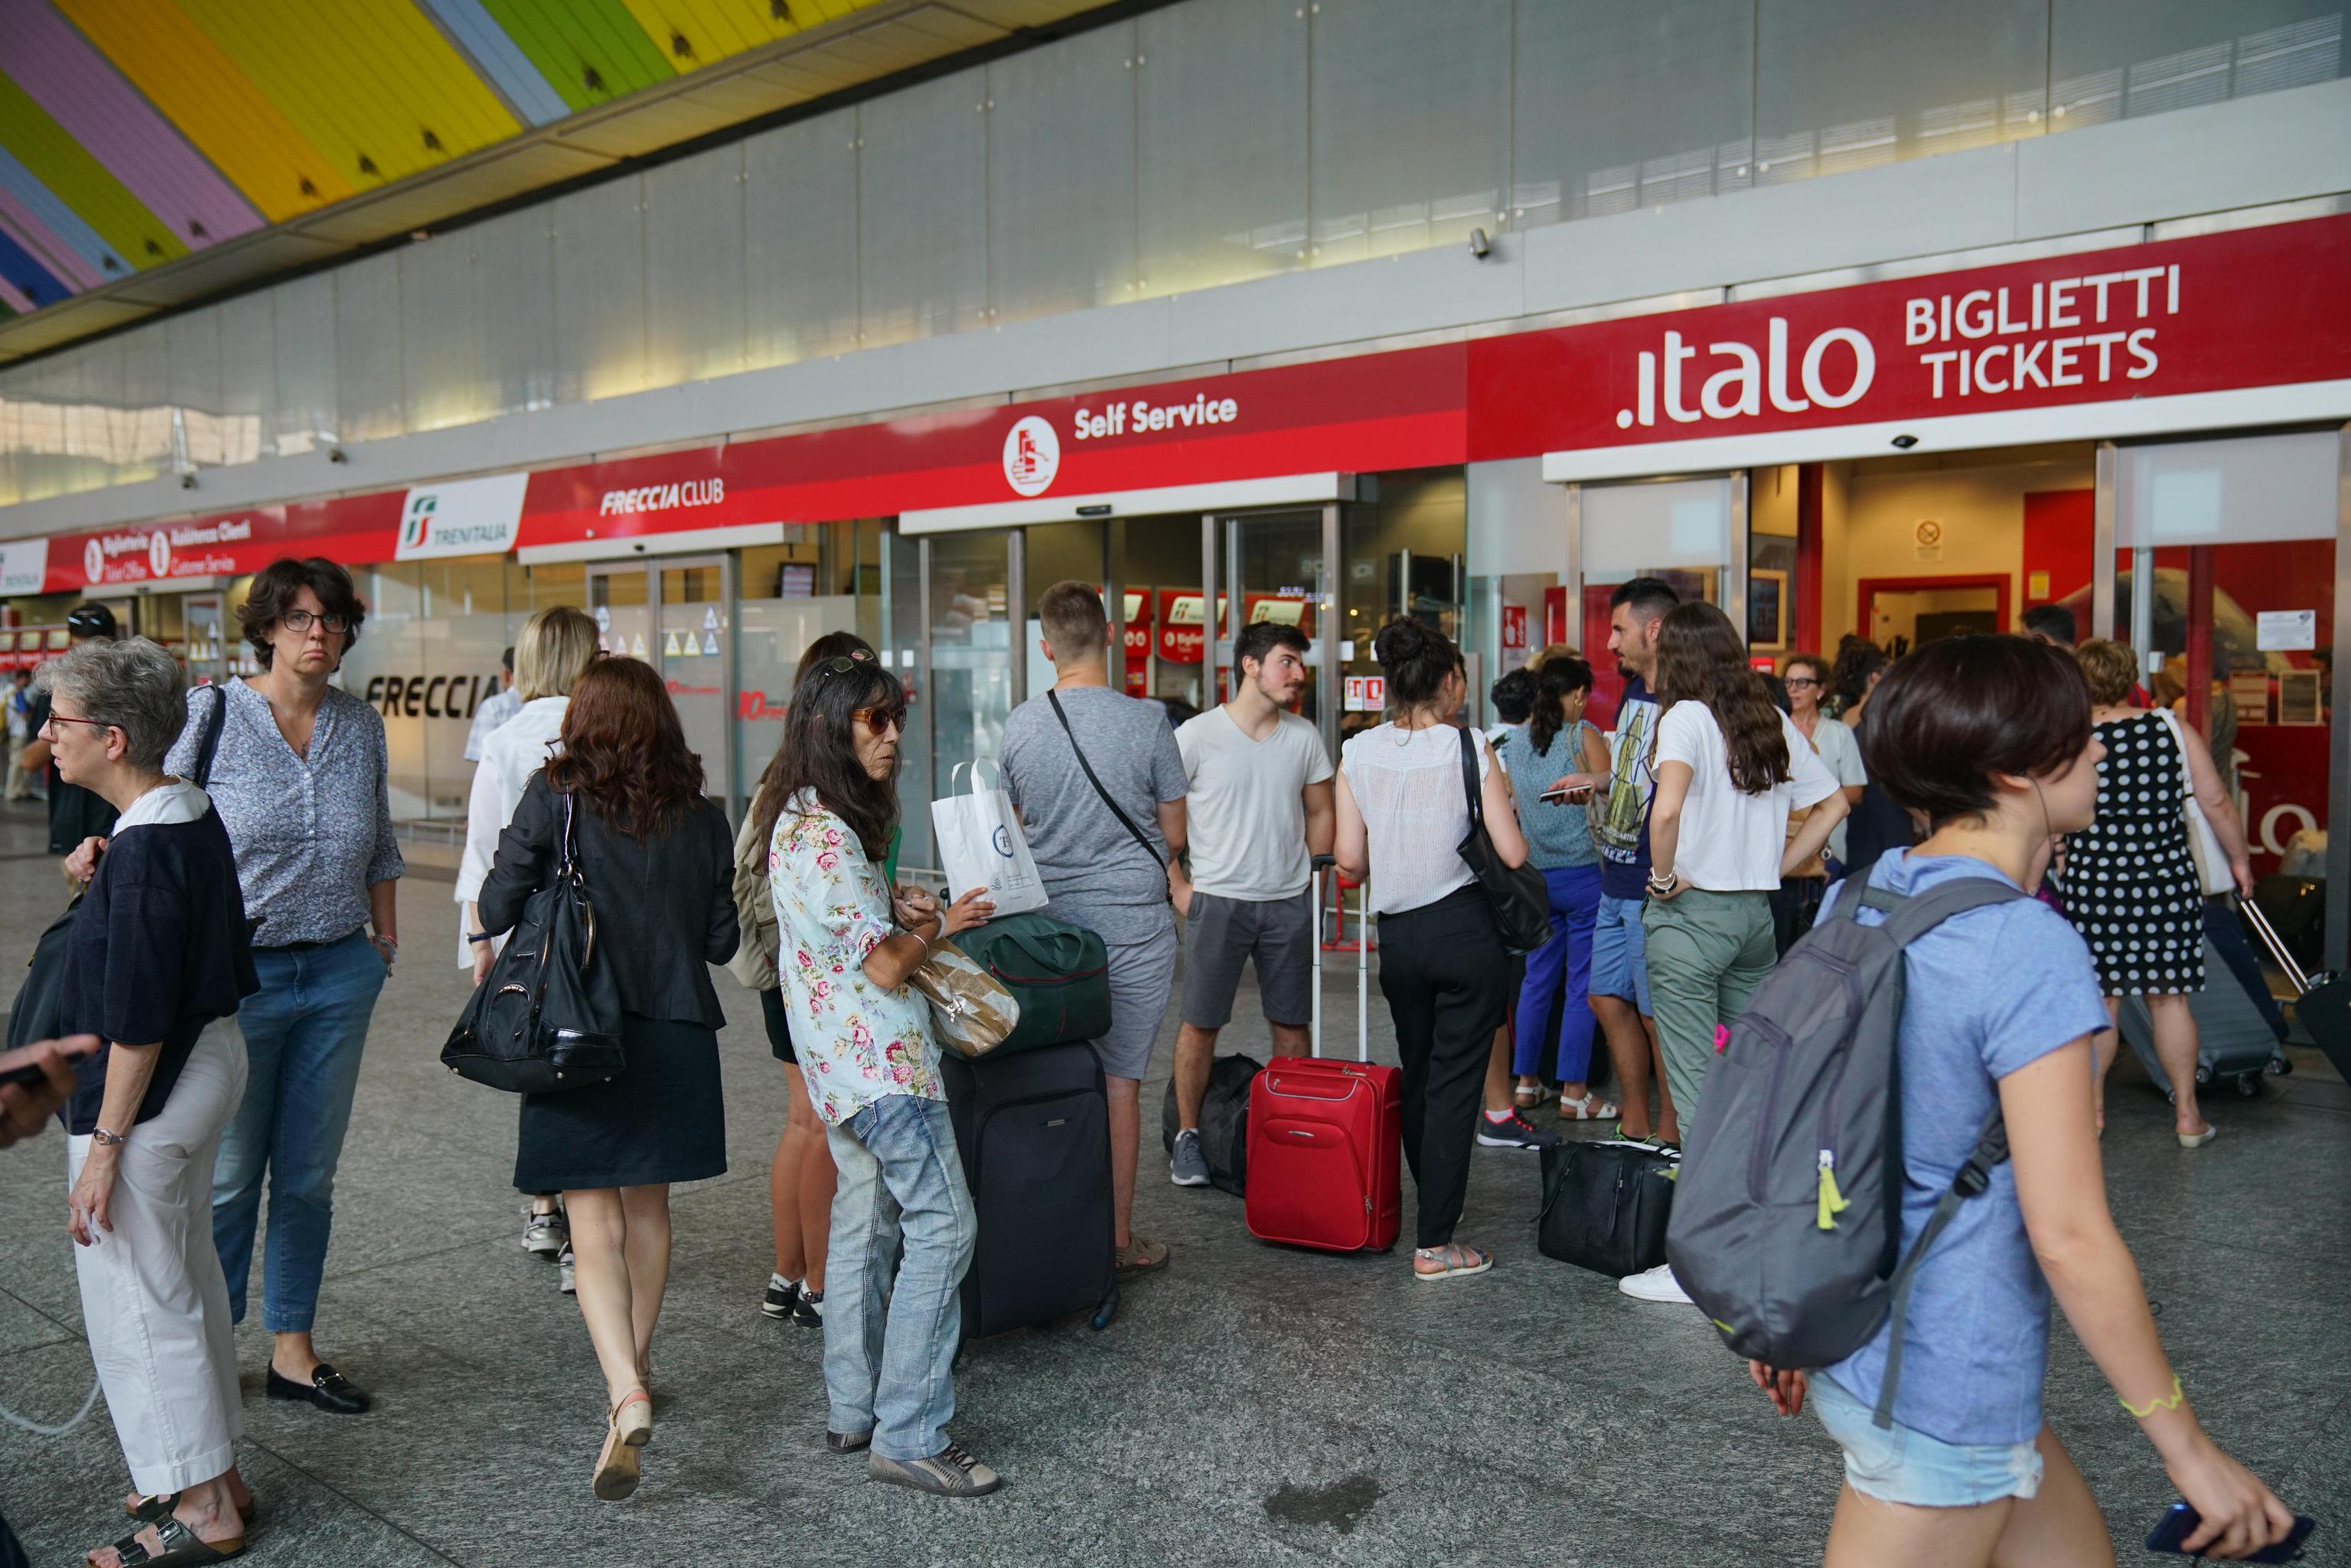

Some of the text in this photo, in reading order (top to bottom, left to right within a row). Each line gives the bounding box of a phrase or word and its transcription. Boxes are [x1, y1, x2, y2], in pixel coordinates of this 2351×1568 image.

[1905, 263, 2180, 346] BIGLIETTI
[1919, 327, 2159, 399] TICKETS
[1074, 392, 1237, 440] Self Service
[435, 523, 507, 546] TRENITALIA
